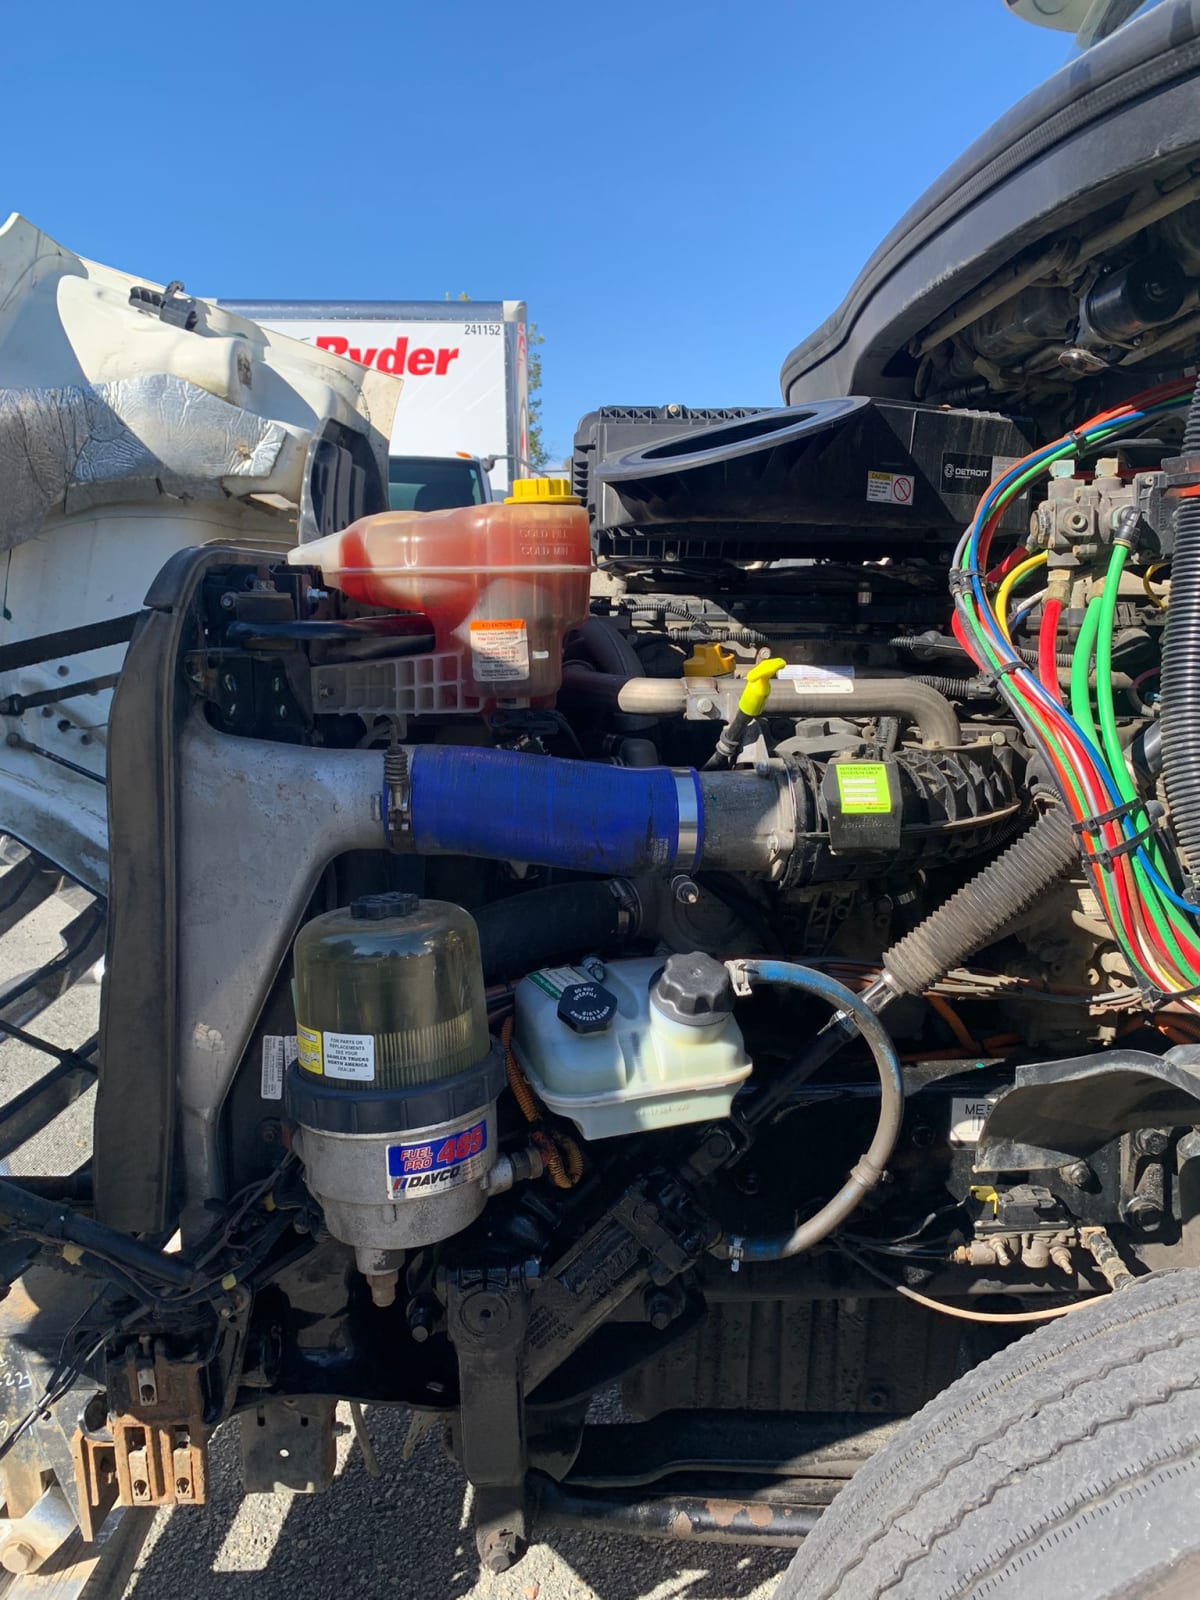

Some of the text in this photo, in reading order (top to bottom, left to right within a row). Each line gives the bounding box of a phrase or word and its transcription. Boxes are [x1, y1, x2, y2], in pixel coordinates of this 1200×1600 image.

[464, 324, 501, 336] 241152
[955, 467, 990, 477] DETROIT
[329, 1043, 365, 1051] REPLACEMENTS
[400, 1125, 482, 1164] FUEL 485
[404, 1157, 432, 1172] PRO
[408, 1166, 461, 1188] DAVCO
